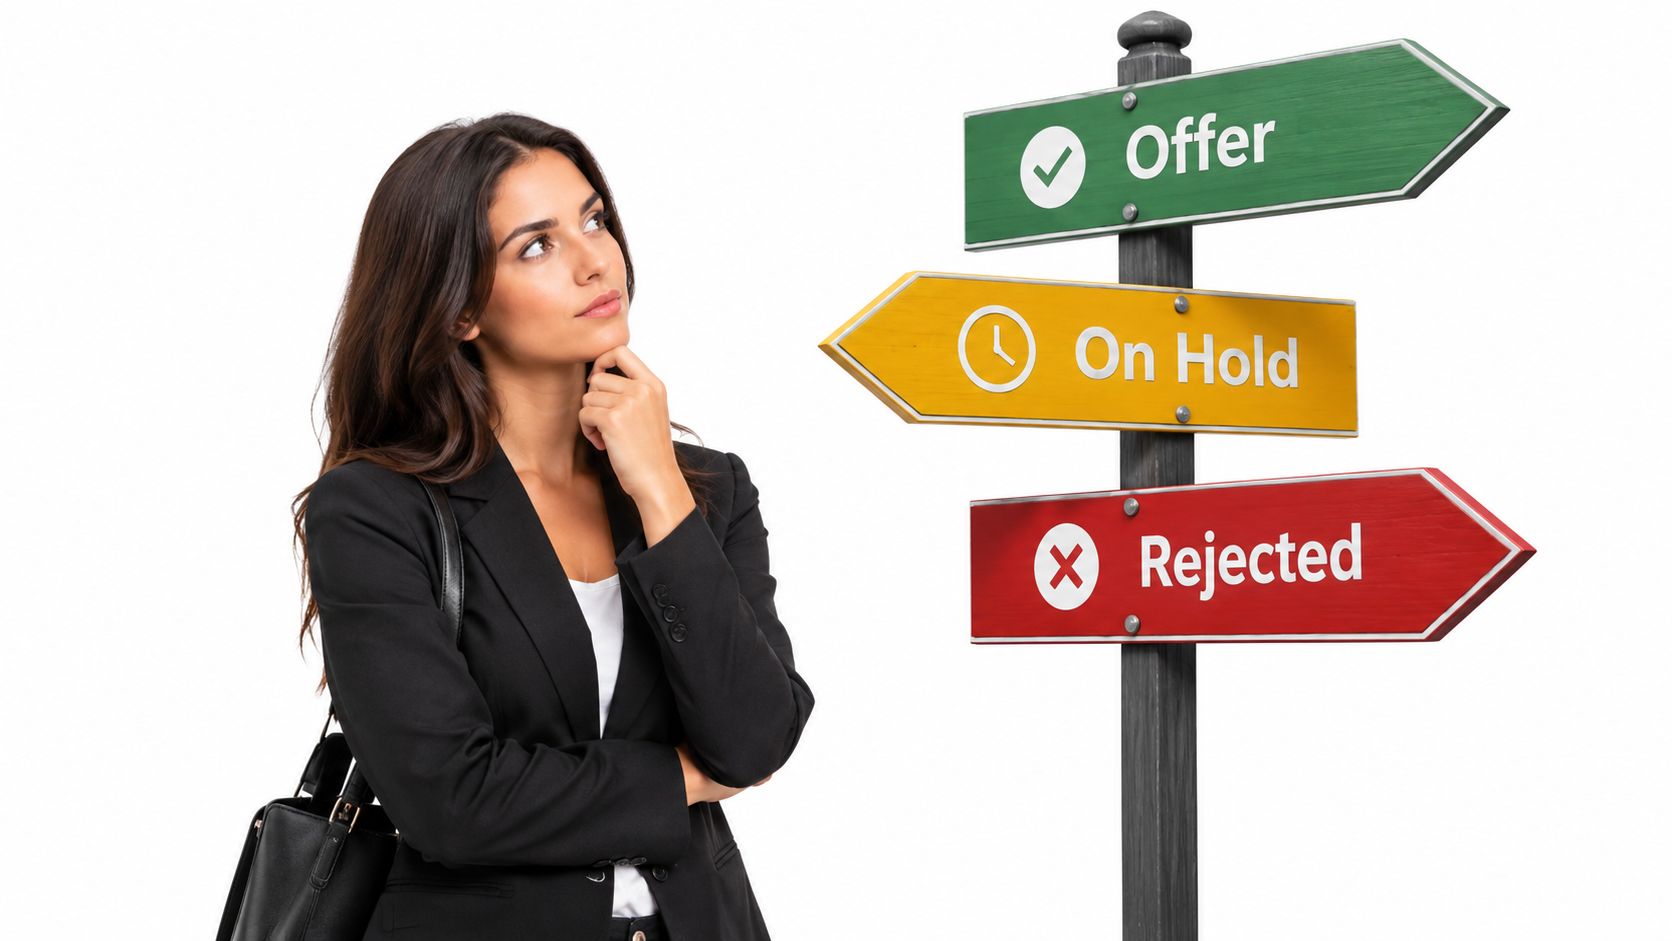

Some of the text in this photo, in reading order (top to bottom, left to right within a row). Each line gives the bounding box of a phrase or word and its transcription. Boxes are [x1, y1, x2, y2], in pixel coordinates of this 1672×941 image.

[1126, 112, 1276, 180] Offer
[1075, 326, 1299, 388] On Hold
[1141, 522, 1362, 601] Rejected
